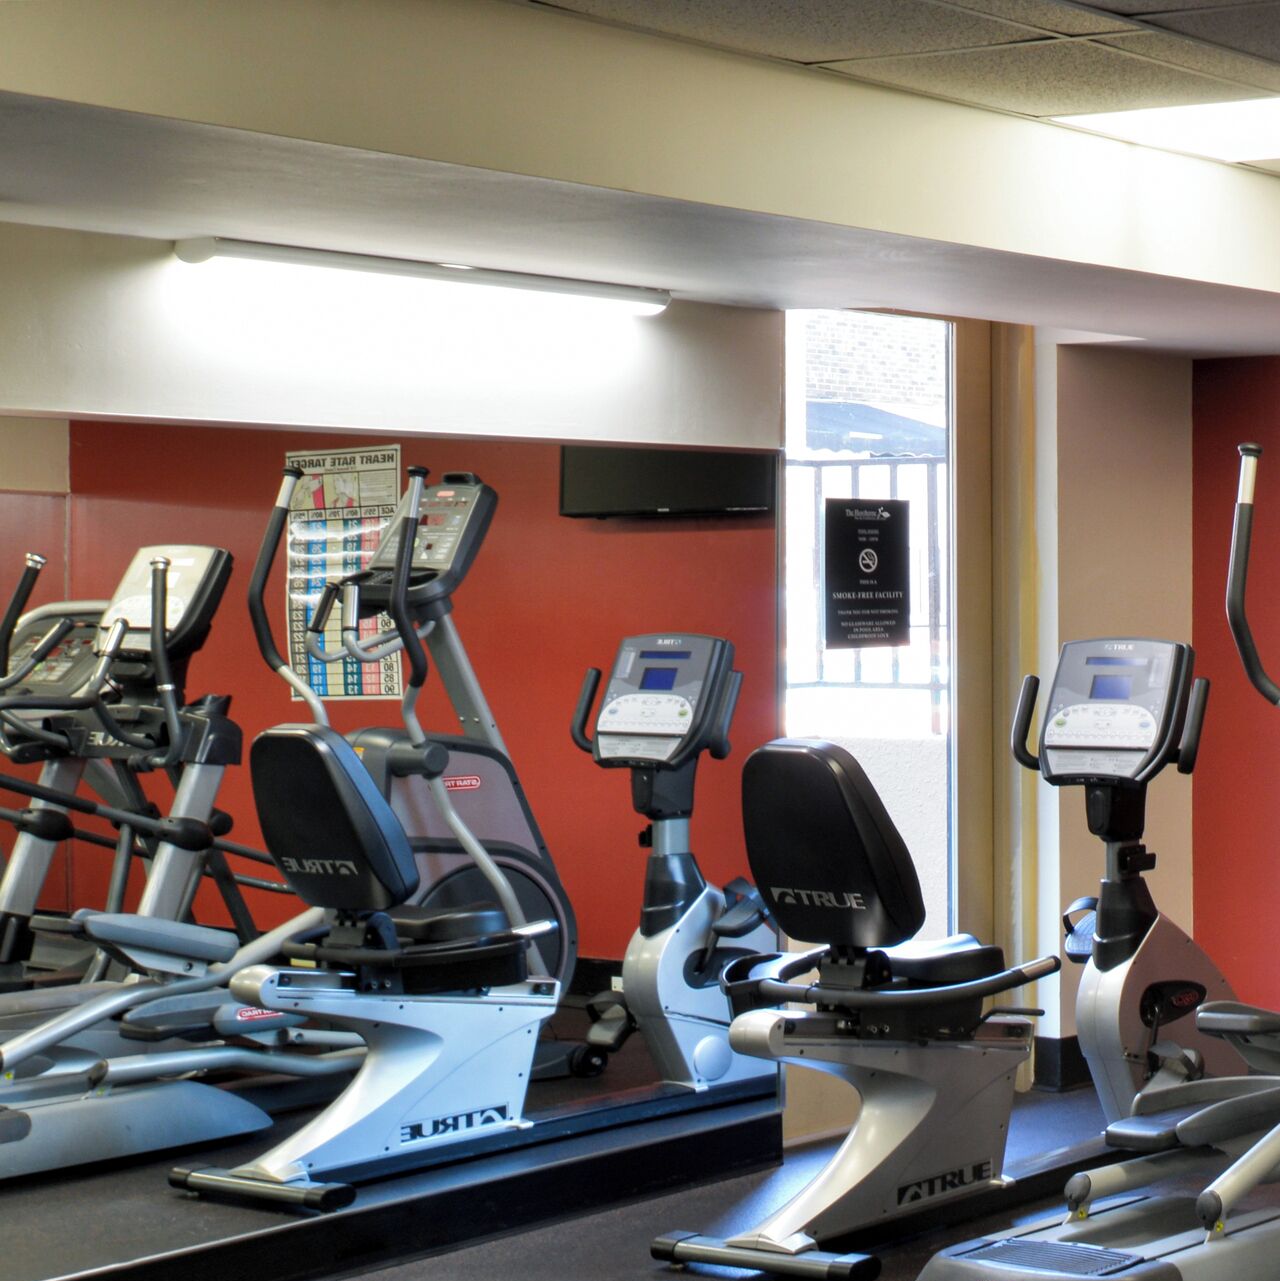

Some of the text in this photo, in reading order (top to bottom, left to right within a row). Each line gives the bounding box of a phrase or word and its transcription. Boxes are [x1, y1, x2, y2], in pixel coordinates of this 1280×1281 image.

[832, 591, 904, 600] SMOKE-FREE FACILITY
[794, 888, 866, 910] TRUE
[921, 1160, 991, 1197] TRUE
